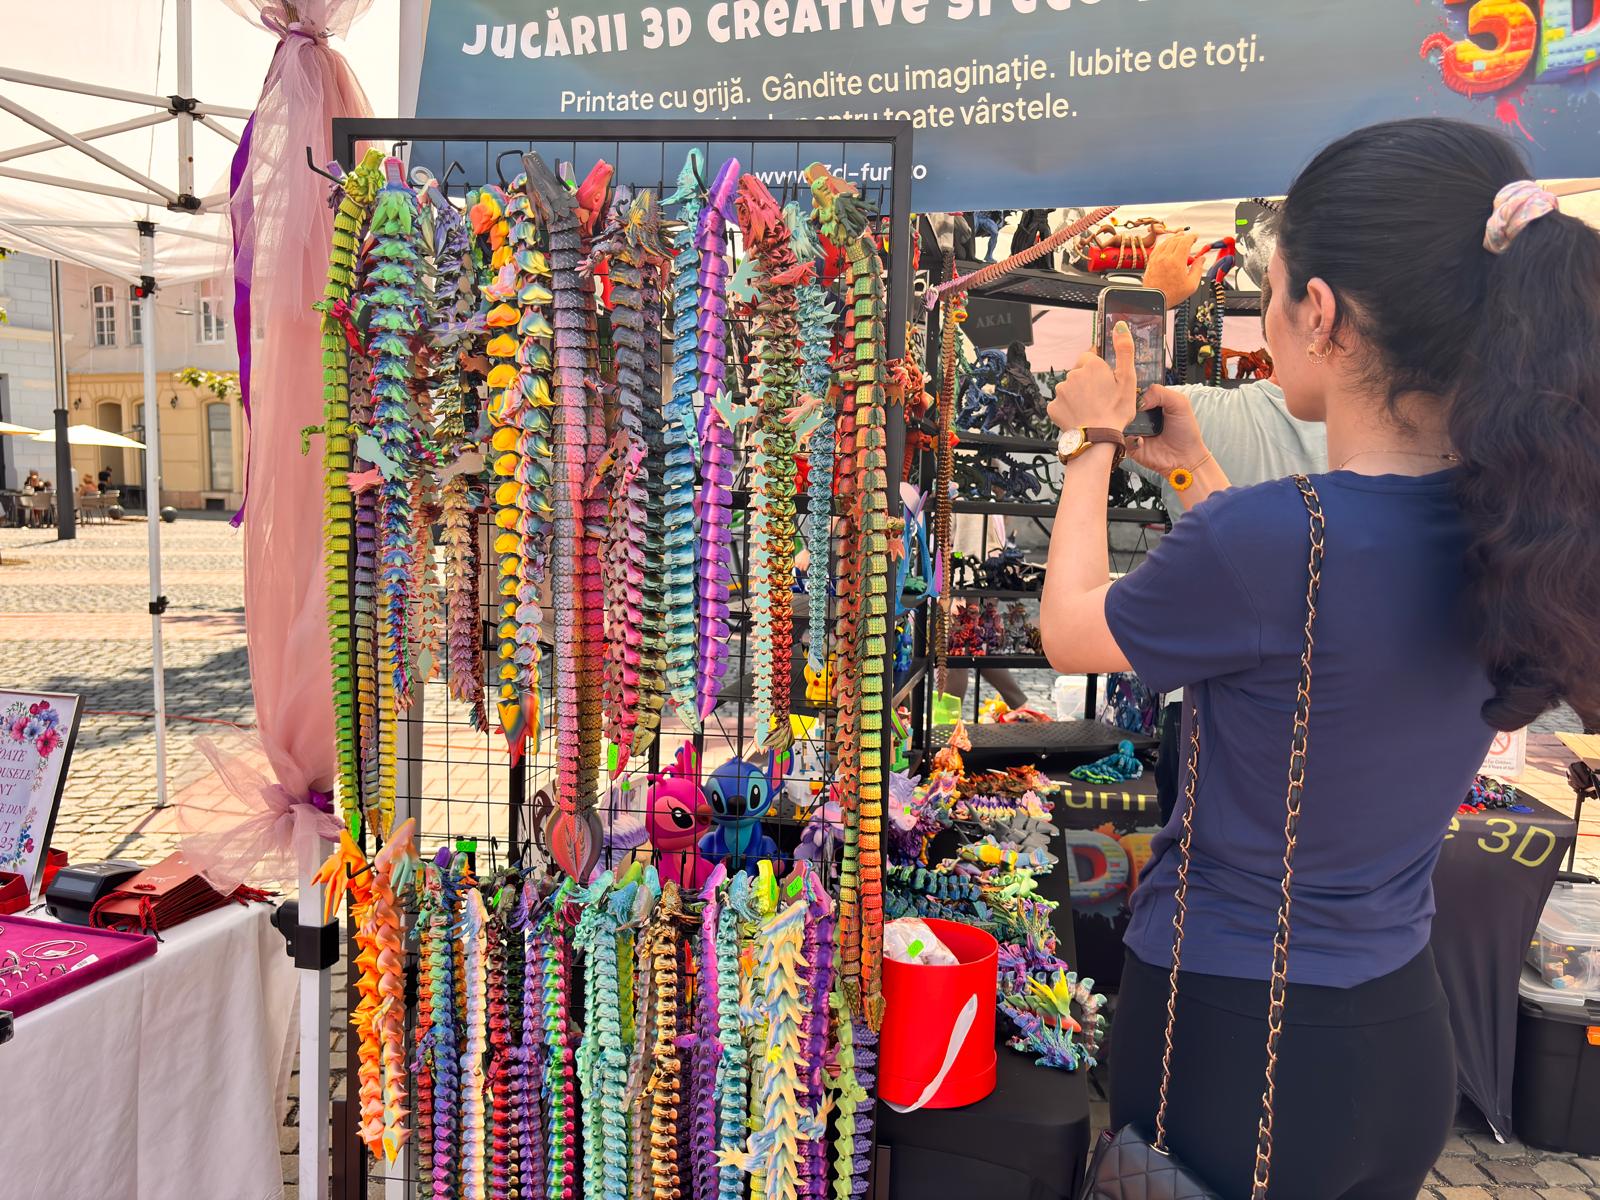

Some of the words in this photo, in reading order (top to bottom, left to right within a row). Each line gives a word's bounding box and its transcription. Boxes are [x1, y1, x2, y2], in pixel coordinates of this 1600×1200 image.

[640, 7, 692, 49] 3D
[560, 90, 654, 113] Printate
[659, 90, 687, 110] cu
[693, 77, 751, 113] grijă.
[762, 71, 862, 102] Gândite
[868, 72, 899, 92] cu
[904, 55, 1056, 93] imaginație.
[1069, 47, 1151, 77] Iubite
[1158, 41, 1197, 70] de
[1203, 34, 1265, 72] toți.
[960, 92, 1078, 126] vârstele.
[975, 312, 1013, 329] AKAI
[1477, 817, 1556, 868] 3D
